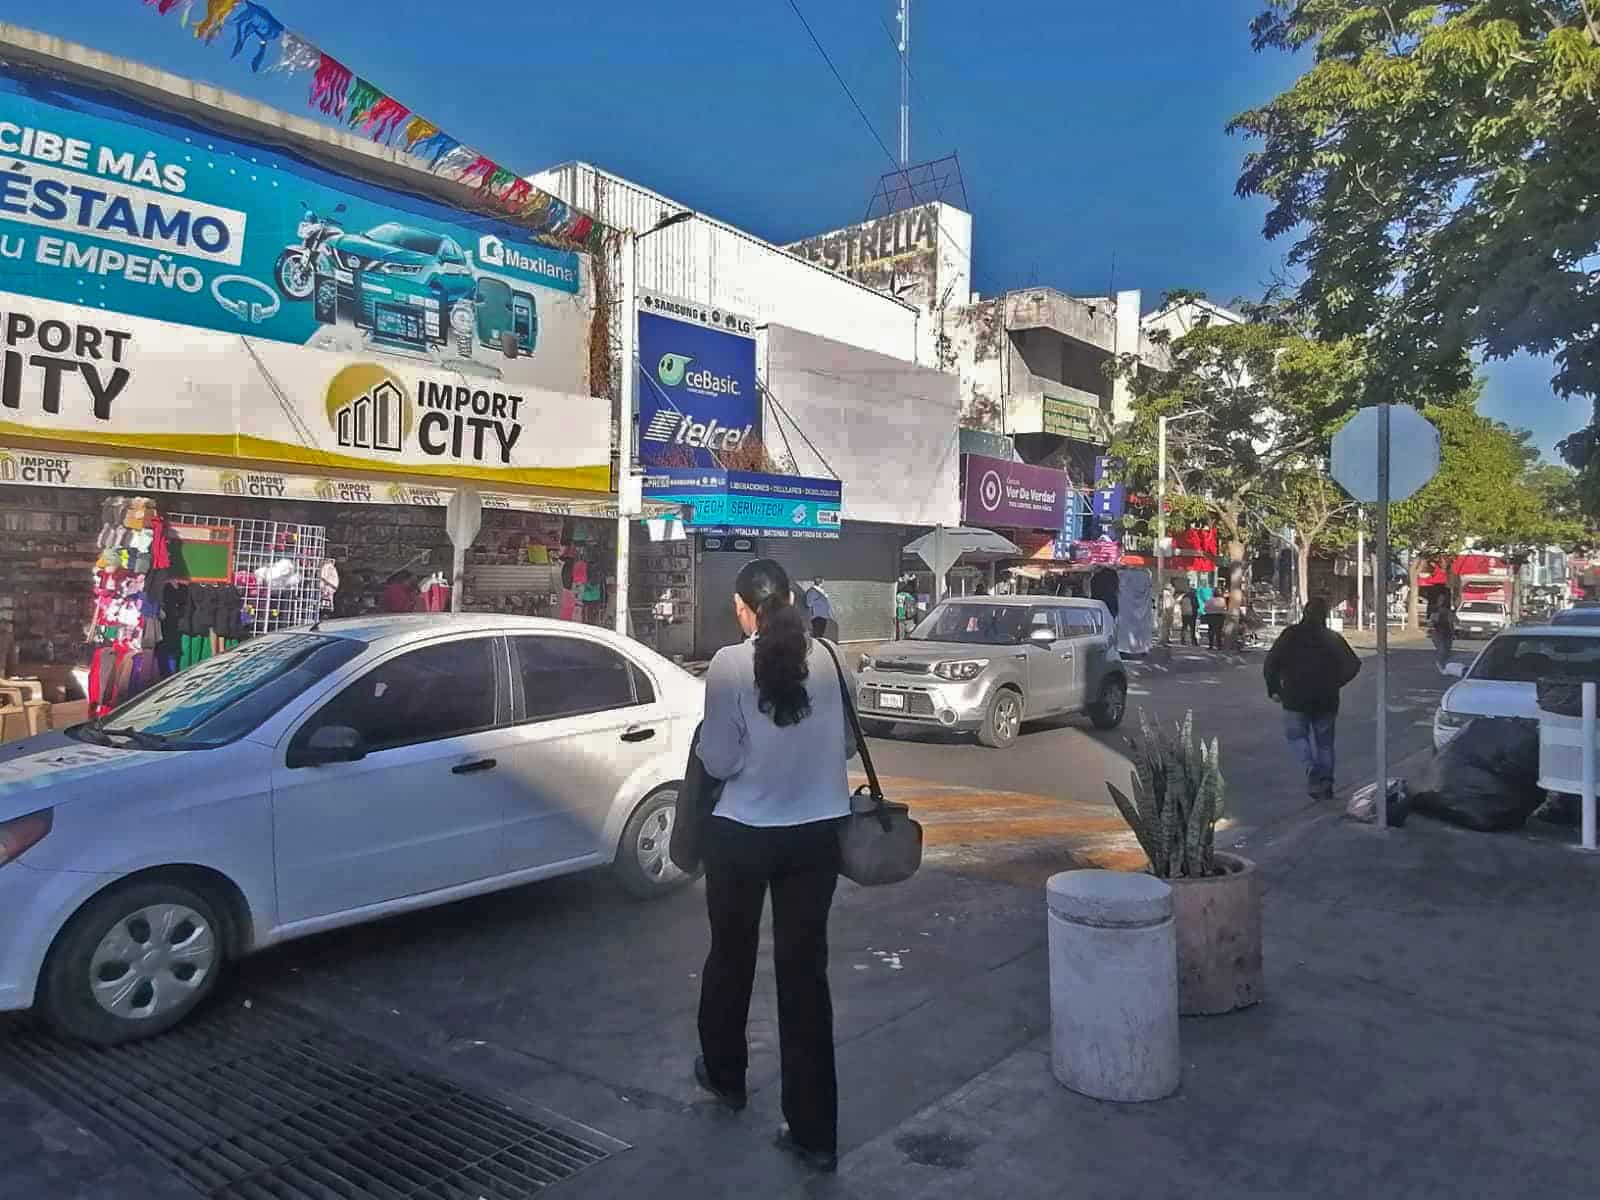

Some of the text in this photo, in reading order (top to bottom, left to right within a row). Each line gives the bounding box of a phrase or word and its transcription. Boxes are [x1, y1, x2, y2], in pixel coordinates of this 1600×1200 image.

[97, 147, 187, 193] MÁS
[0, 161, 231, 254] ÉSTAMO
[35, 236, 204, 293] EMPEÑO
[505, 249, 574, 282] Maxilana
[654, 298, 751, 333] SAMSUNG LG
[6, 312, 132, 363] PORT
[1, 350, 130, 420] ITY
[686, 370, 739, 394] ceBasic
[417, 381, 523, 421] IMPORT
[418, 412, 522, 463] CITY
[20, 456, 71, 469] IMPORT
[22, 466, 71, 483] CITY
[142, 466, 185, 479] IMPORT
[143, 475, 184, 490] CITY
[247, 474, 284, 486] IMPORT
[249, 483, 285, 497] CITY
[338, 483, 370, 491] IMPORT
[340, 490, 371, 502] CITY
[1006, 486, 1056, 503] Ver De Verdad
